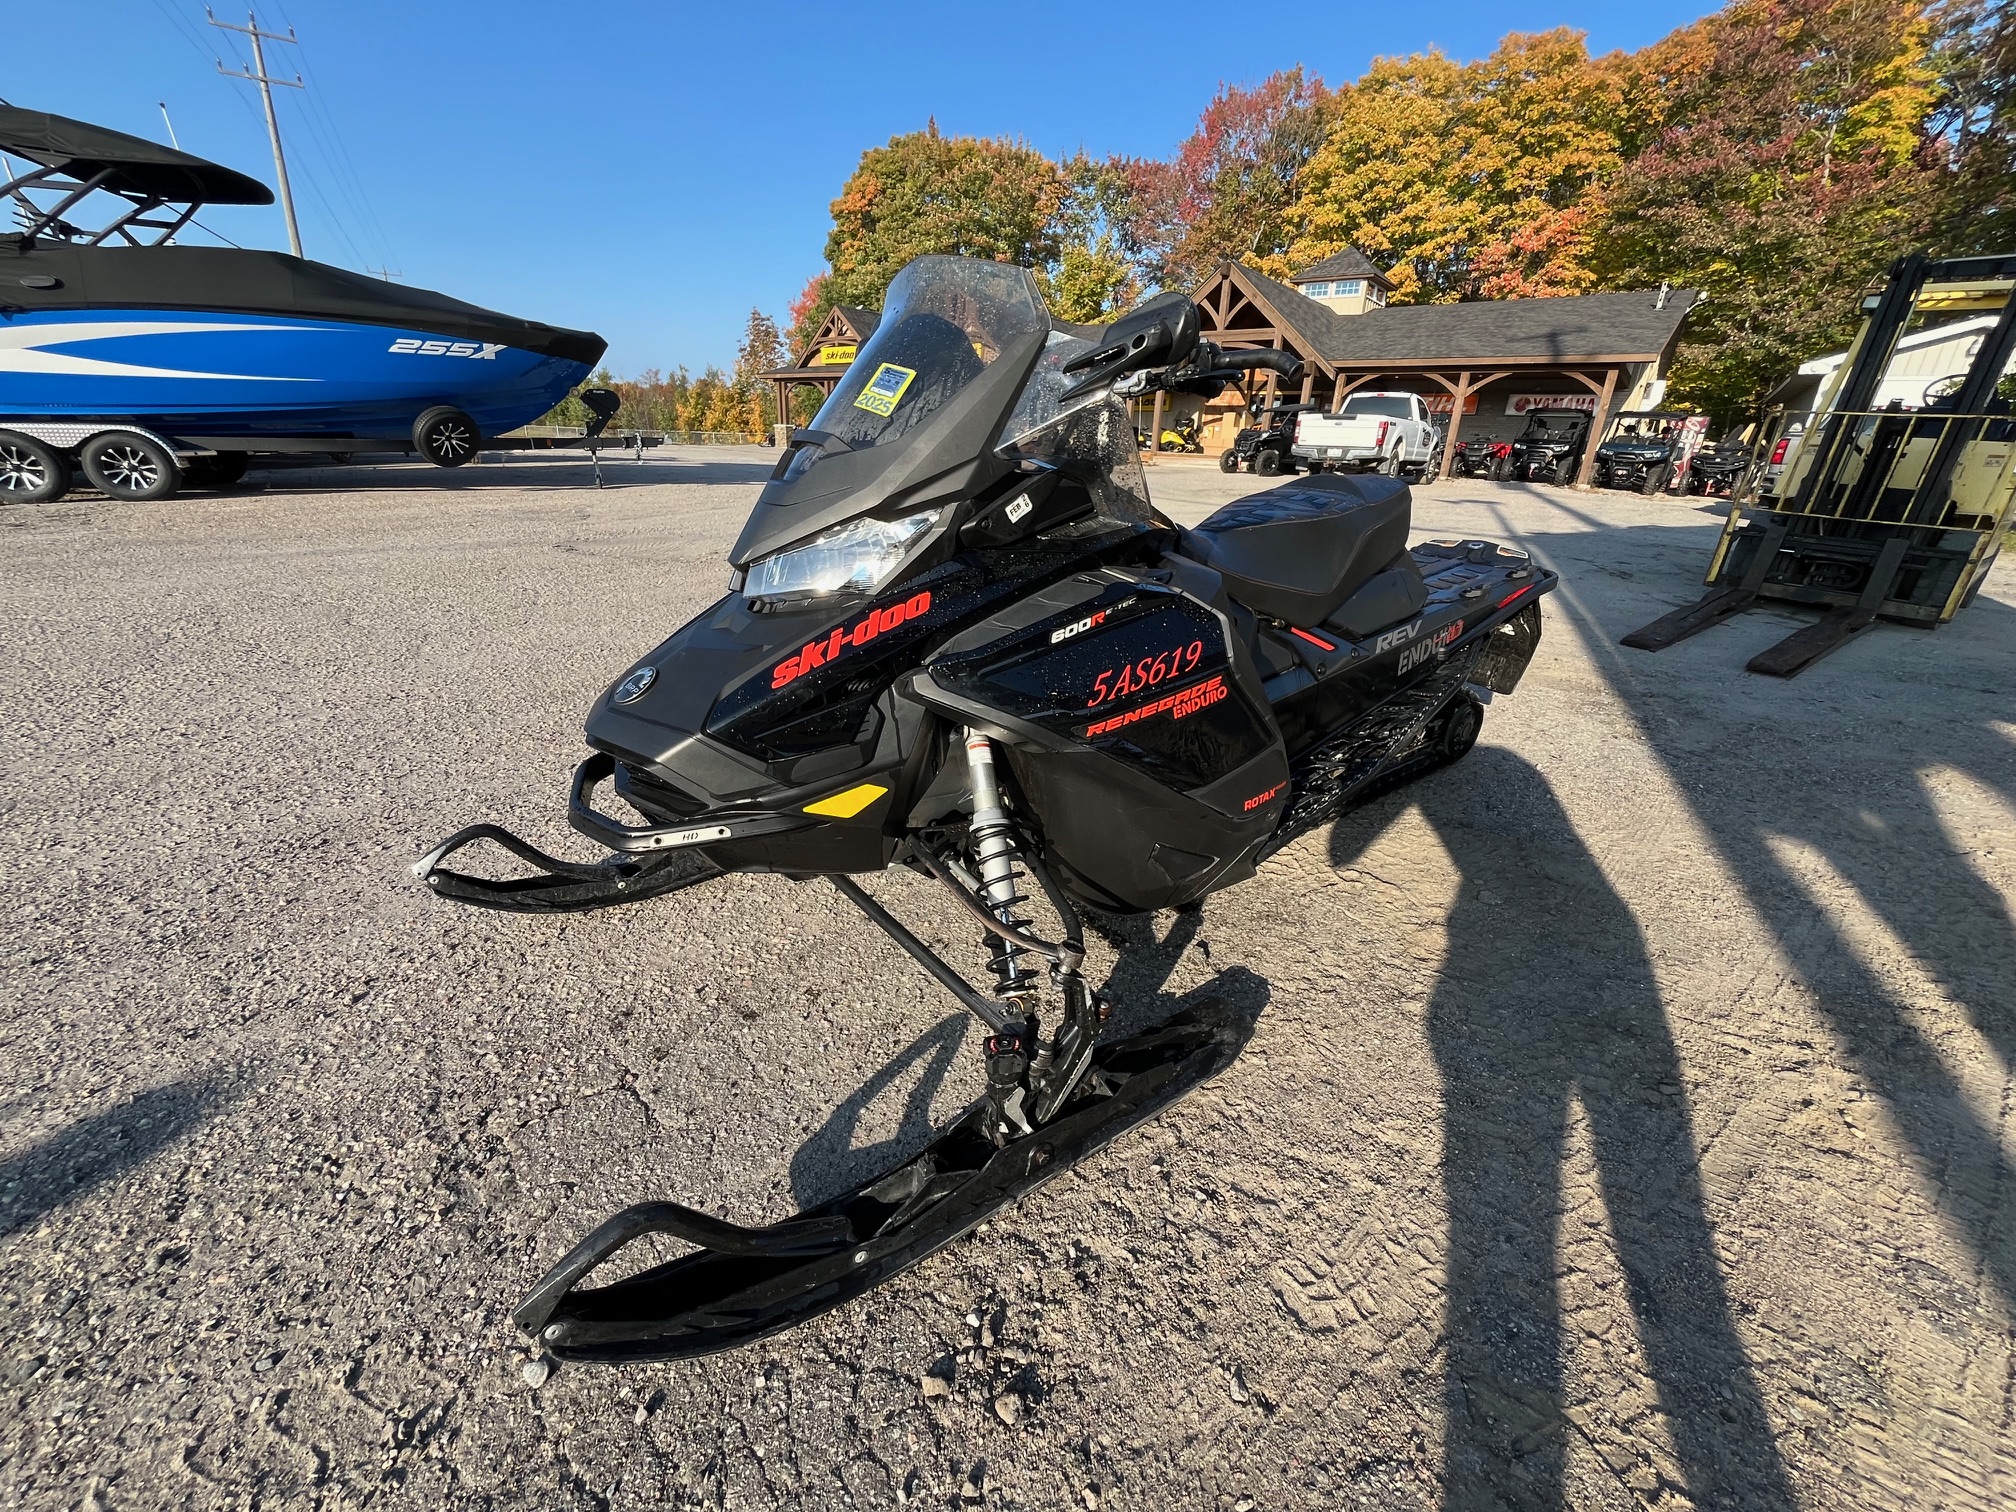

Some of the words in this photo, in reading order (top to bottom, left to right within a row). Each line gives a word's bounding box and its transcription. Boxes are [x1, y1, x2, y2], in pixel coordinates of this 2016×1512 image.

[388, 338, 508, 360] 255X
[825, 350, 855, 360] ski-doo
[856, 393, 893, 413] 2025
[1422, 396, 1467, 411] TIH
[1533, 397, 1596, 411] YAMAHA
[1010, 503, 1022, 516] FEB
[772, 591, 931, 689] ski-doo
[1376, 620, 1422, 654] REV
[1087, 640, 1203, 707] 5AS619
[1086, 675, 1223, 737] RENEGADE
[1173, 685, 1228, 720] ENDURO
[1244, 788, 1276, 811] ROTAX
